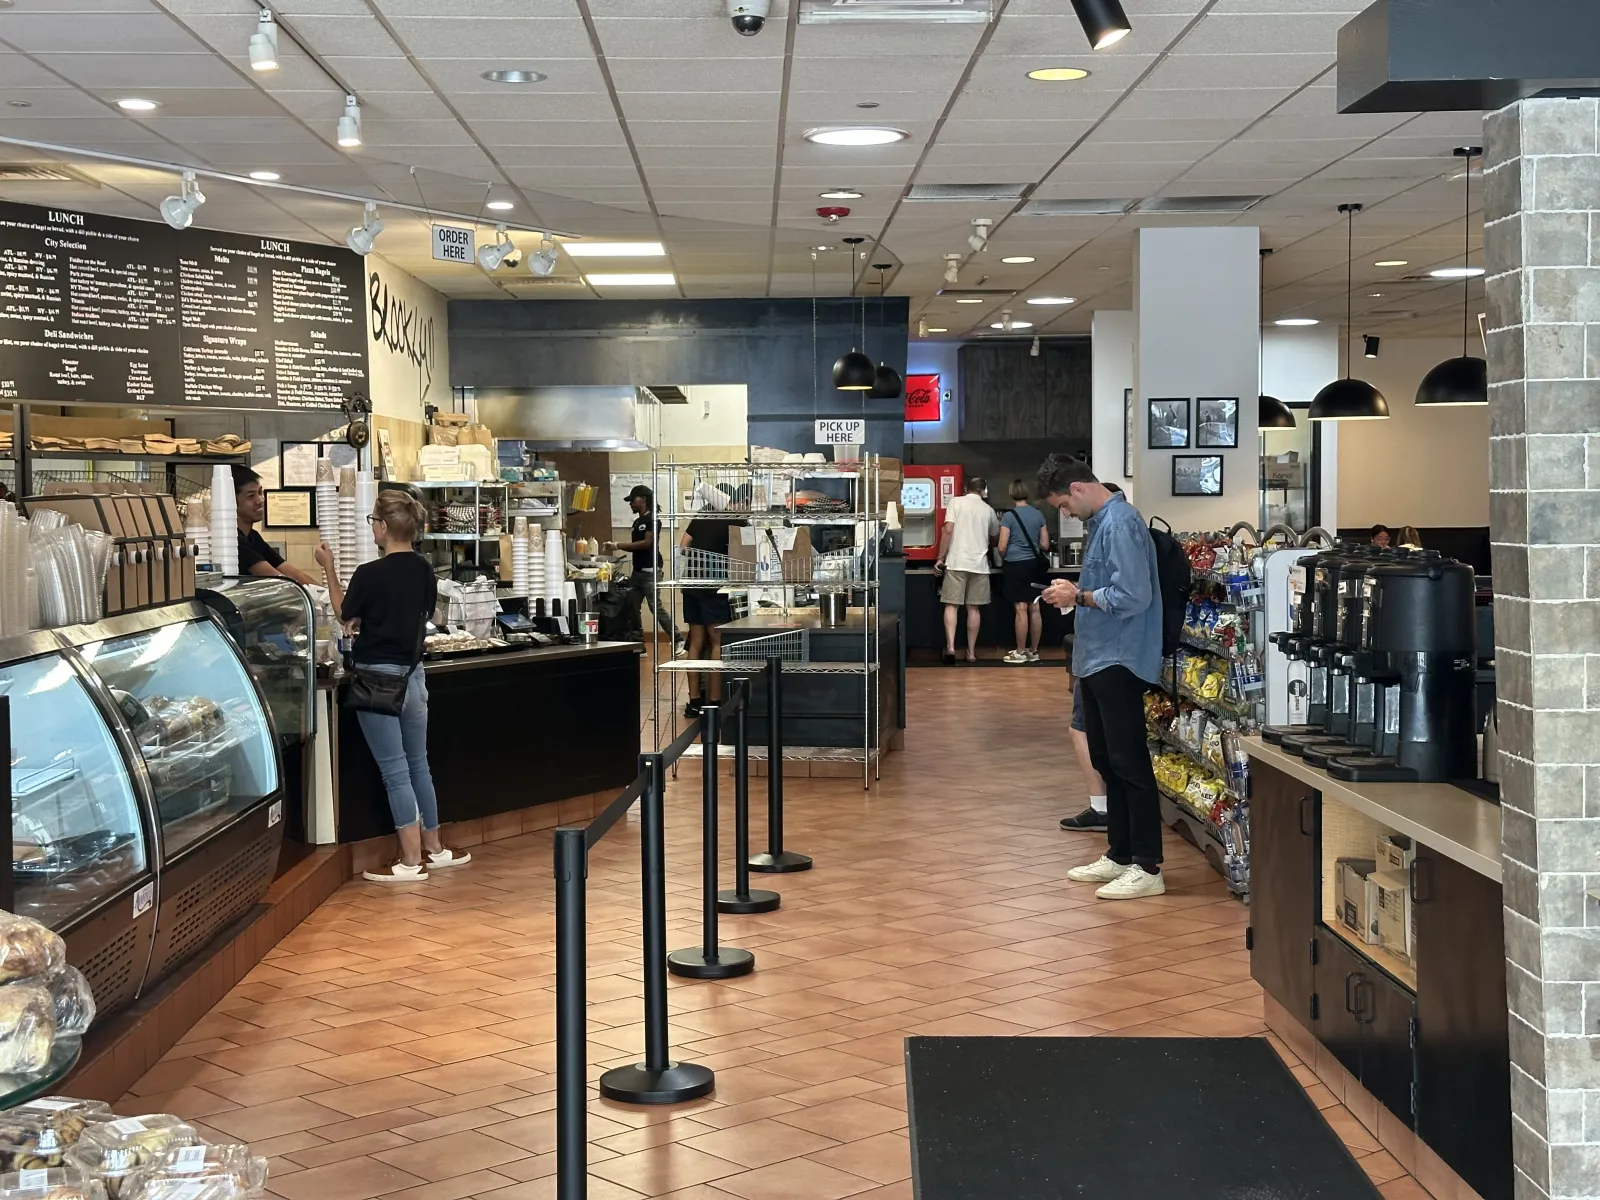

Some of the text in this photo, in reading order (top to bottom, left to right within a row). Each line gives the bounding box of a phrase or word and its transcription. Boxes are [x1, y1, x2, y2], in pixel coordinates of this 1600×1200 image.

[48, 212, 84, 225] LUNCH
[439, 229, 468, 245] ORDER
[45, 238, 87, 250] City Selection
[260, 241, 290, 252] LUNCH
[444, 244, 465, 260] HERE
[214, 255, 230, 263] Melts
[300, 266, 331, 276] Pizza Bagels
[44, 329, 94, 340] Deli Sandwiches
[202, 335, 247, 346] Signature Wraps
[905, 388, 932, 404] Cola
[820, 422, 860, 431] PICK UP
[827, 432, 853, 442] HERE
